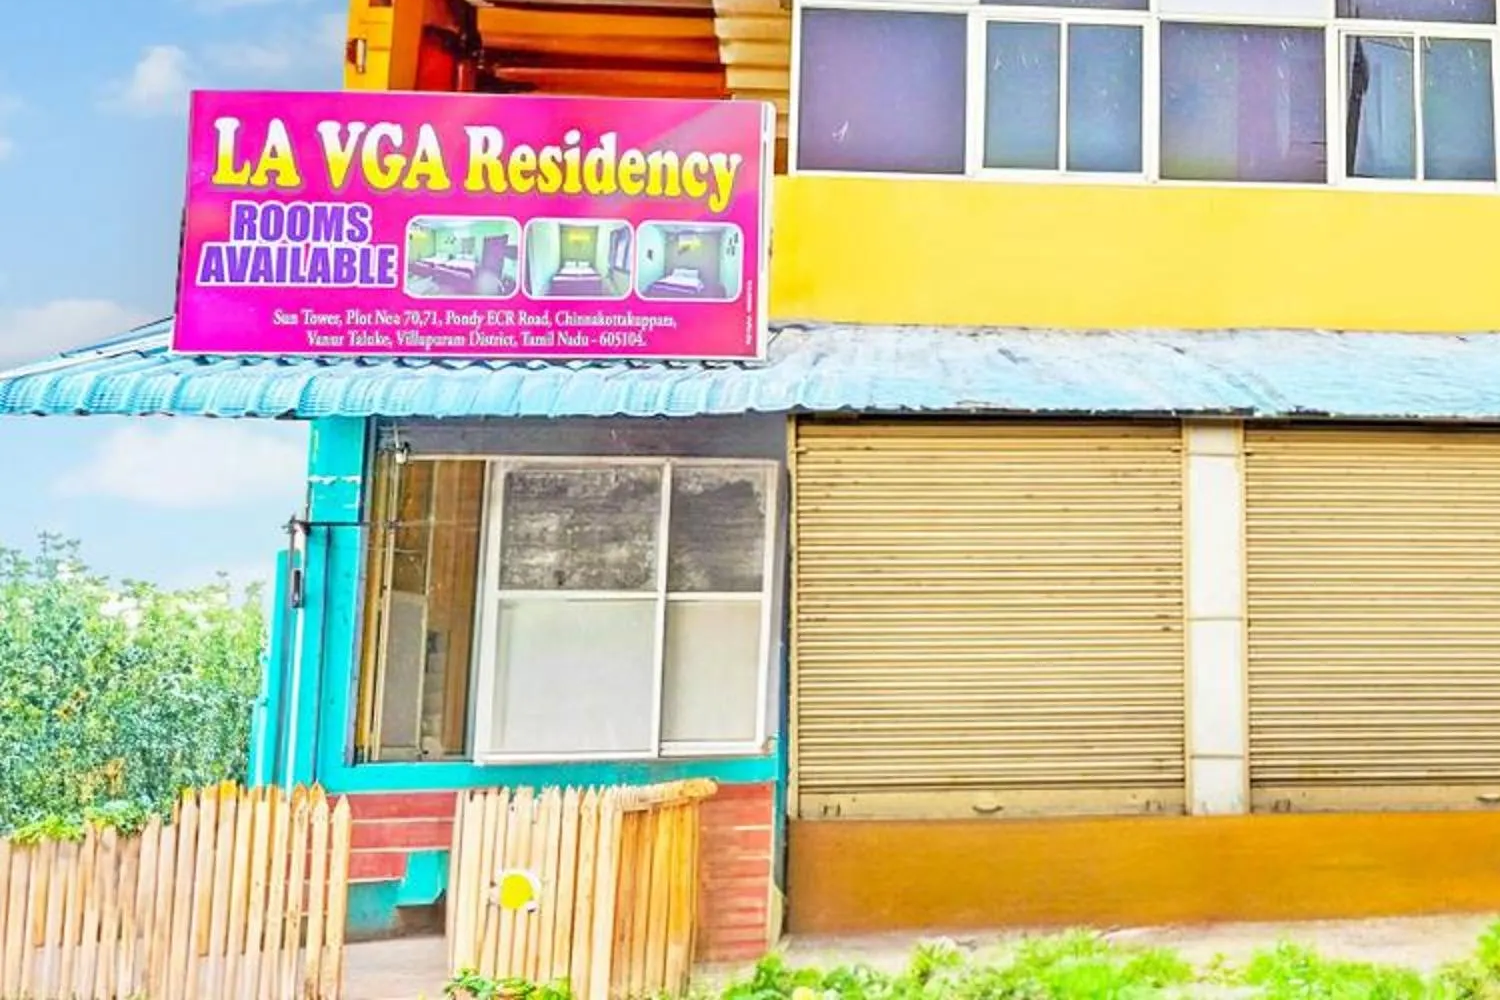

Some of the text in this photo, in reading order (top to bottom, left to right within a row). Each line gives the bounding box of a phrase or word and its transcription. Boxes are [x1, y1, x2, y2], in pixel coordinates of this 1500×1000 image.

[211, 117, 743, 212] LA VGA Residency
[231, 202, 371, 242] ROOMS
[198, 243, 397, 286] AVAILABLE
[273, 308, 298, 325] Sun
[302, 309, 343, 328] Tower,
[345, 309, 372, 325] Plot
[445, 310, 483, 330] Pondy
[487, 311, 515, 326] ECR
[518, 311, 551, 329] Road,
[469, 331, 518, 347] District,
[521, 332, 554, 347] Tamil
[557, 332, 588, 347] Nadu
